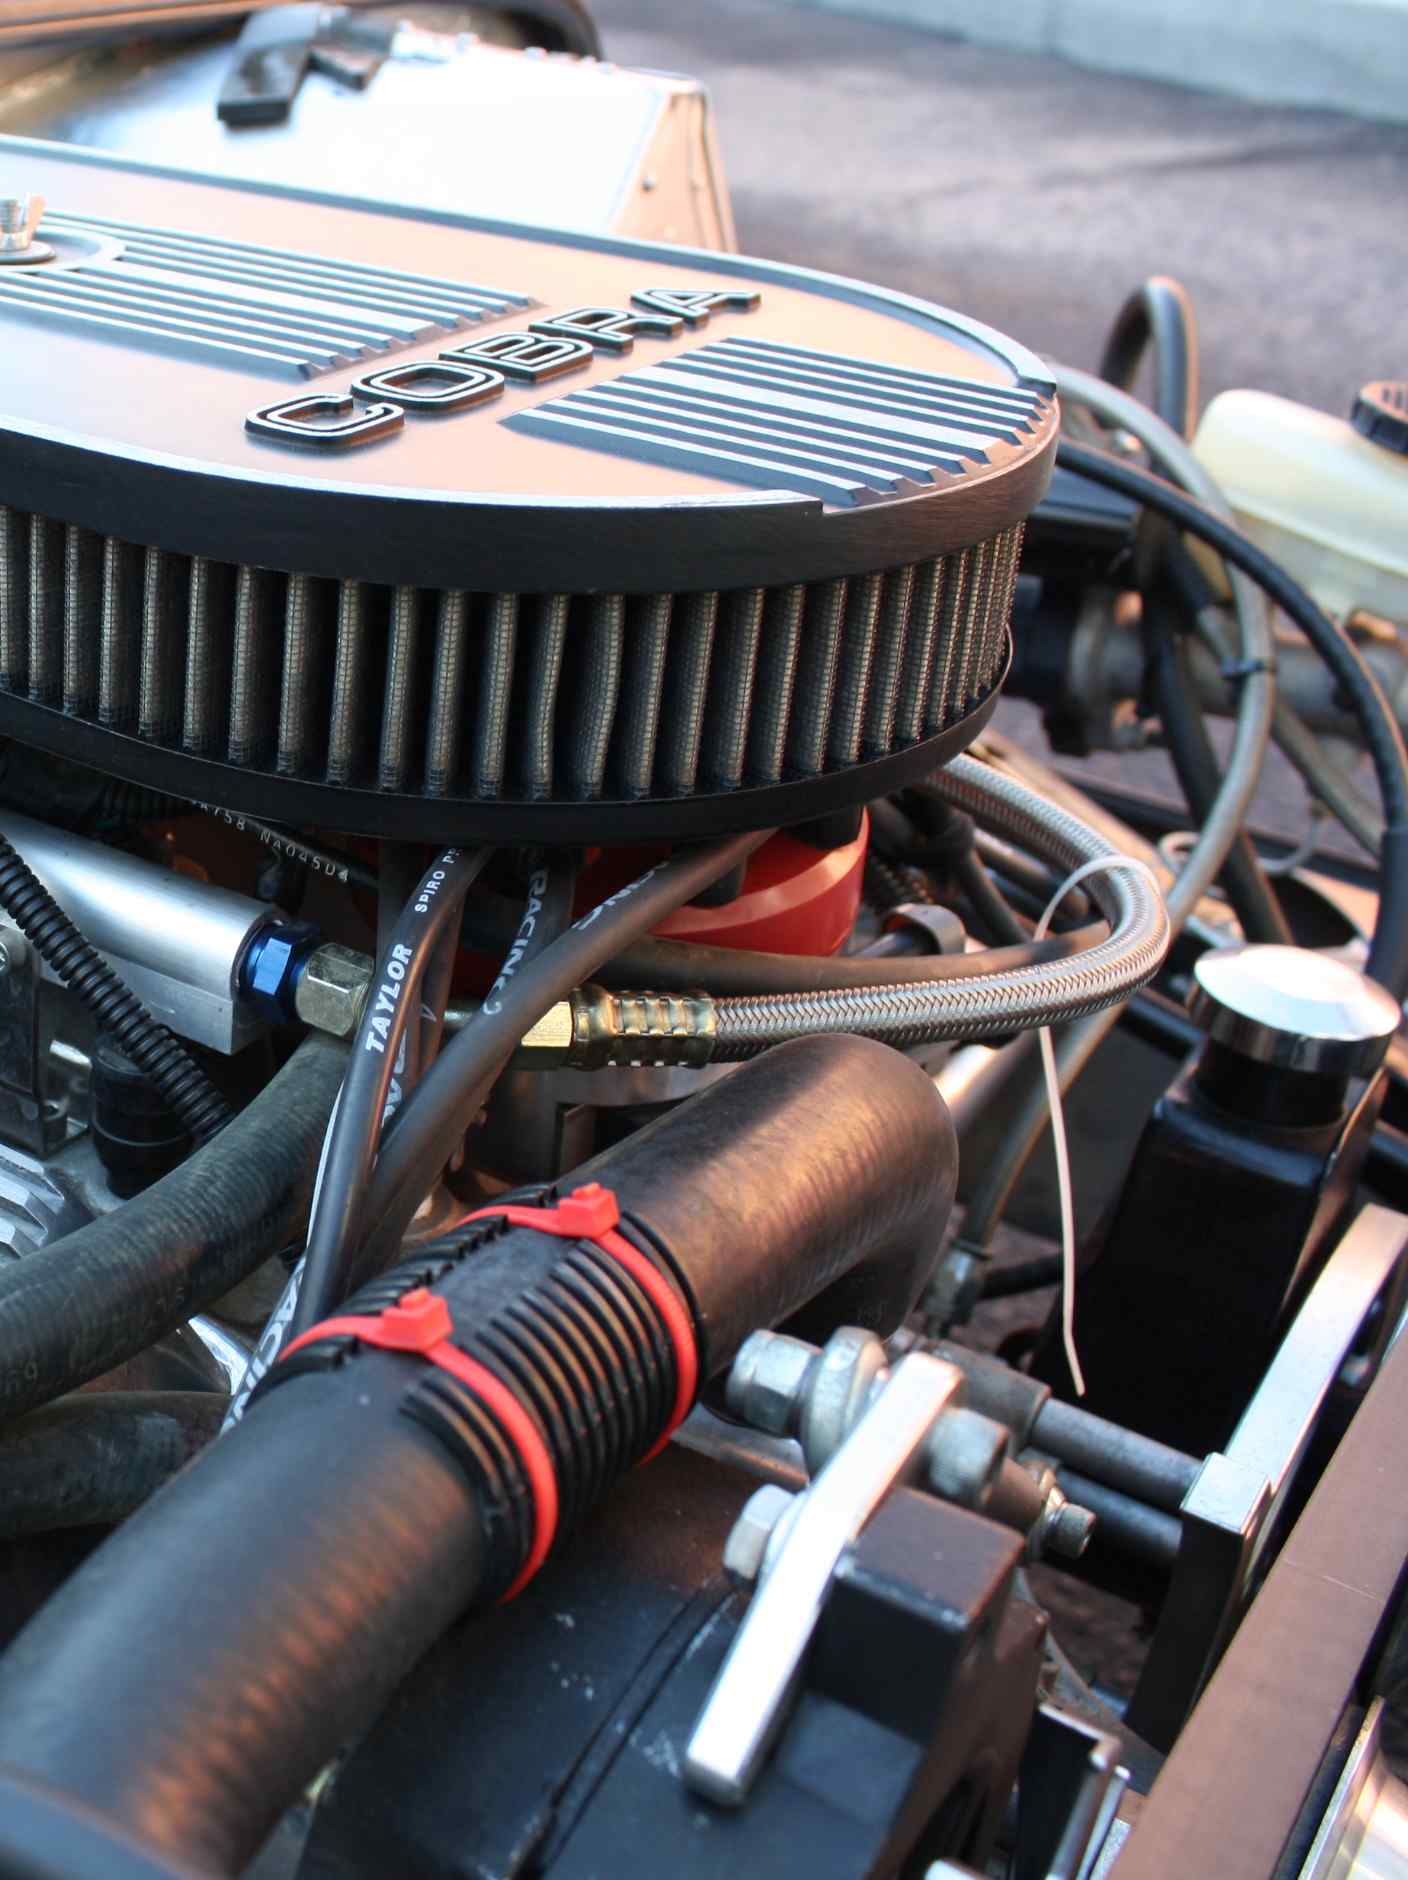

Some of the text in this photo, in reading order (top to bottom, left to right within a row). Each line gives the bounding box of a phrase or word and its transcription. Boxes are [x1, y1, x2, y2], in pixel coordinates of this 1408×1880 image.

[244, 288, 761, 446] COBRA
[366, 943, 413, 1053] TAYLOR
[414, 870, 446, 913] SPIRO
